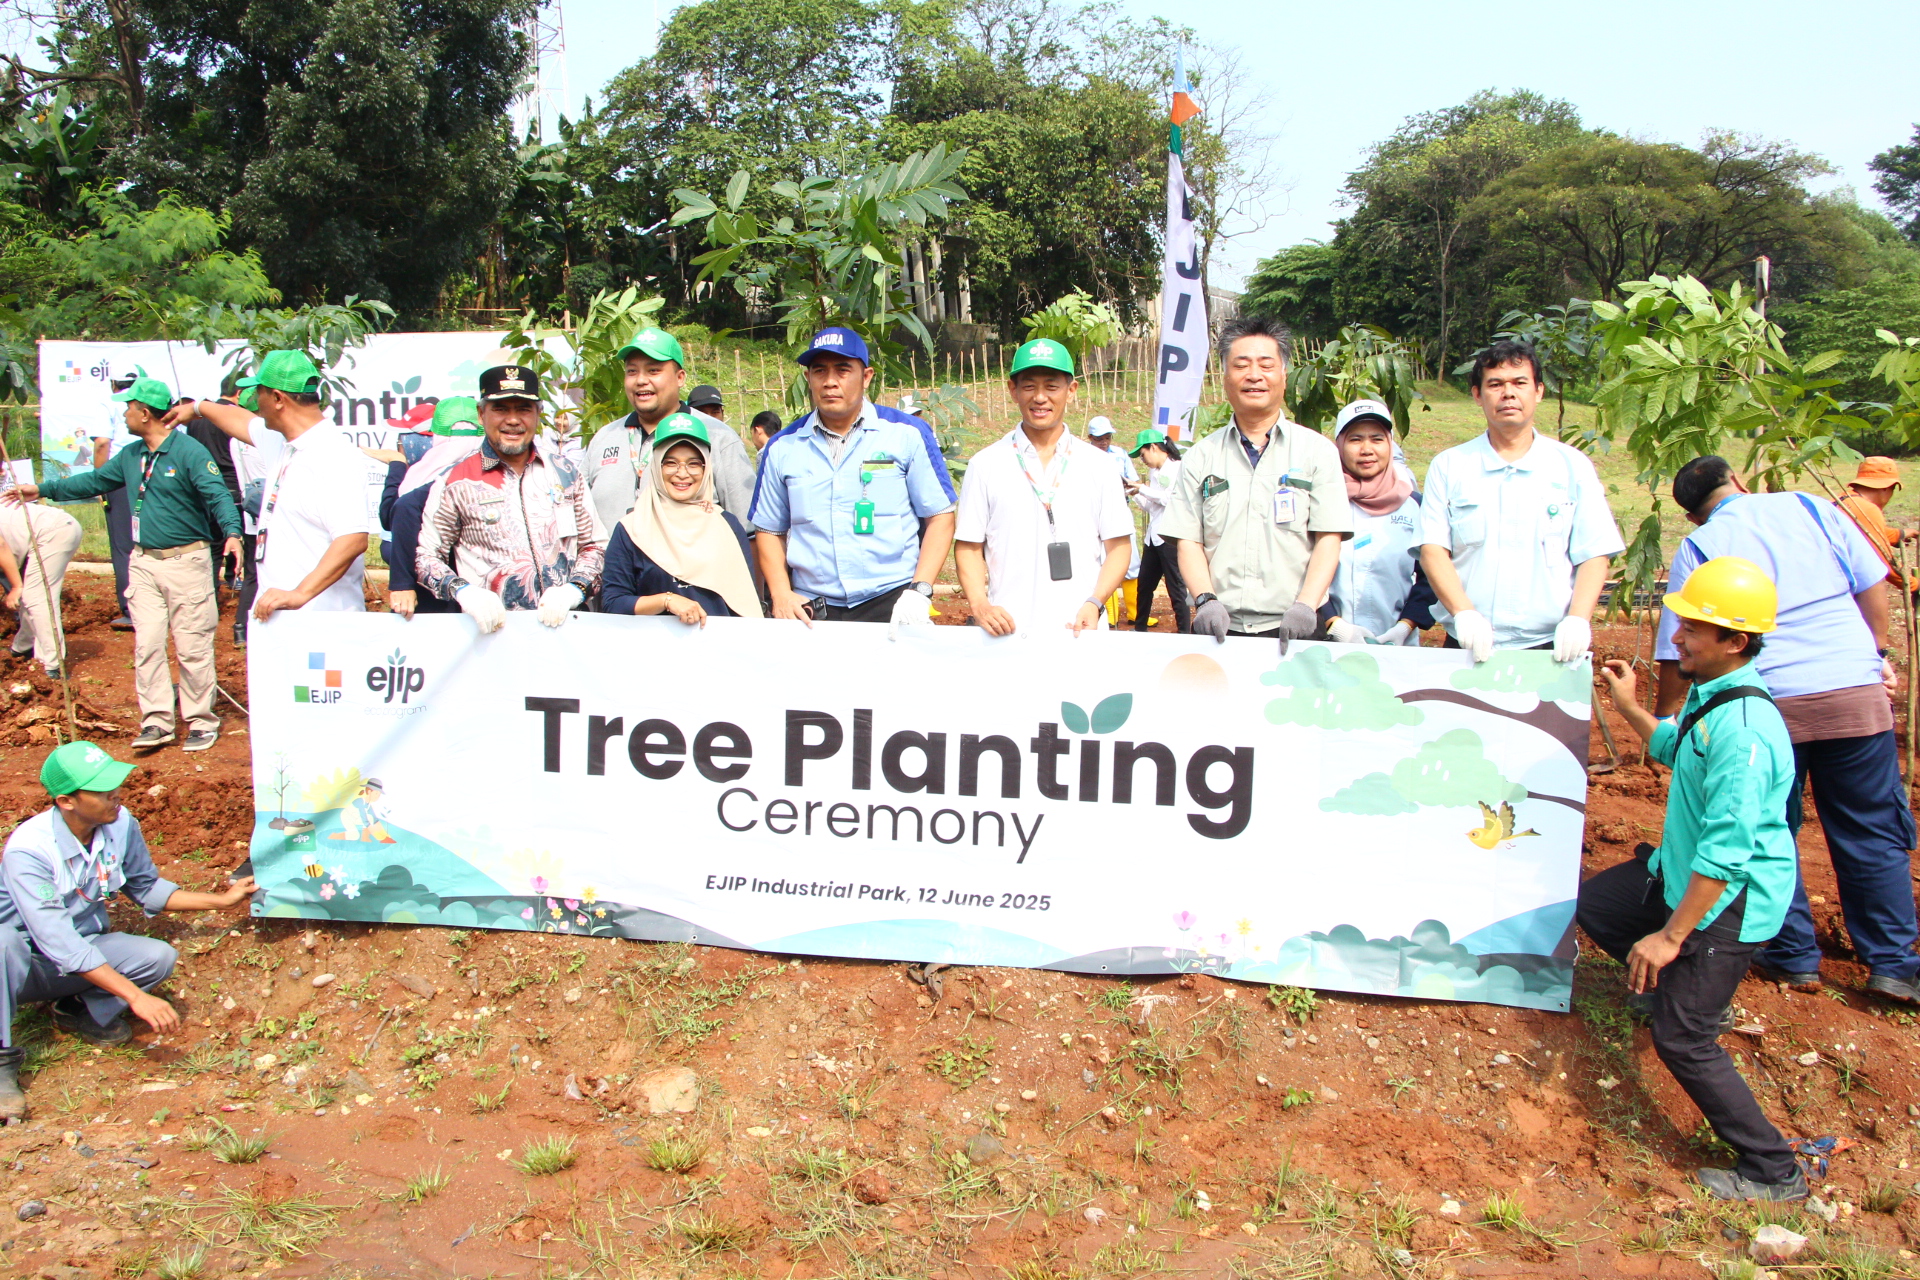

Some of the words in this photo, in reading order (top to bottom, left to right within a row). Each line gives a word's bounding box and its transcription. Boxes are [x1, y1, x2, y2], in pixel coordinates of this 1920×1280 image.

[813, 333, 844, 349] SAKURA
[90, 364, 109, 382] eji
[603, 446, 620, 459] CSR
[310, 689, 342, 704] EJIP
[366, 662, 425, 704] ejip
[525, 696, 753, 783] Tree
[785, 706, 1254, 840] Planting
[717, 787, 1044, 864] Ceremony
[705, 875, 747, 891] EJIP
[751, 878, 853, 899] Industrial
[858, 884, 911, 905] Park,
[918, 888, 938, 903] 12
[942, 890, 995, 908] June
[999, 893, 1052, 911] 2025
